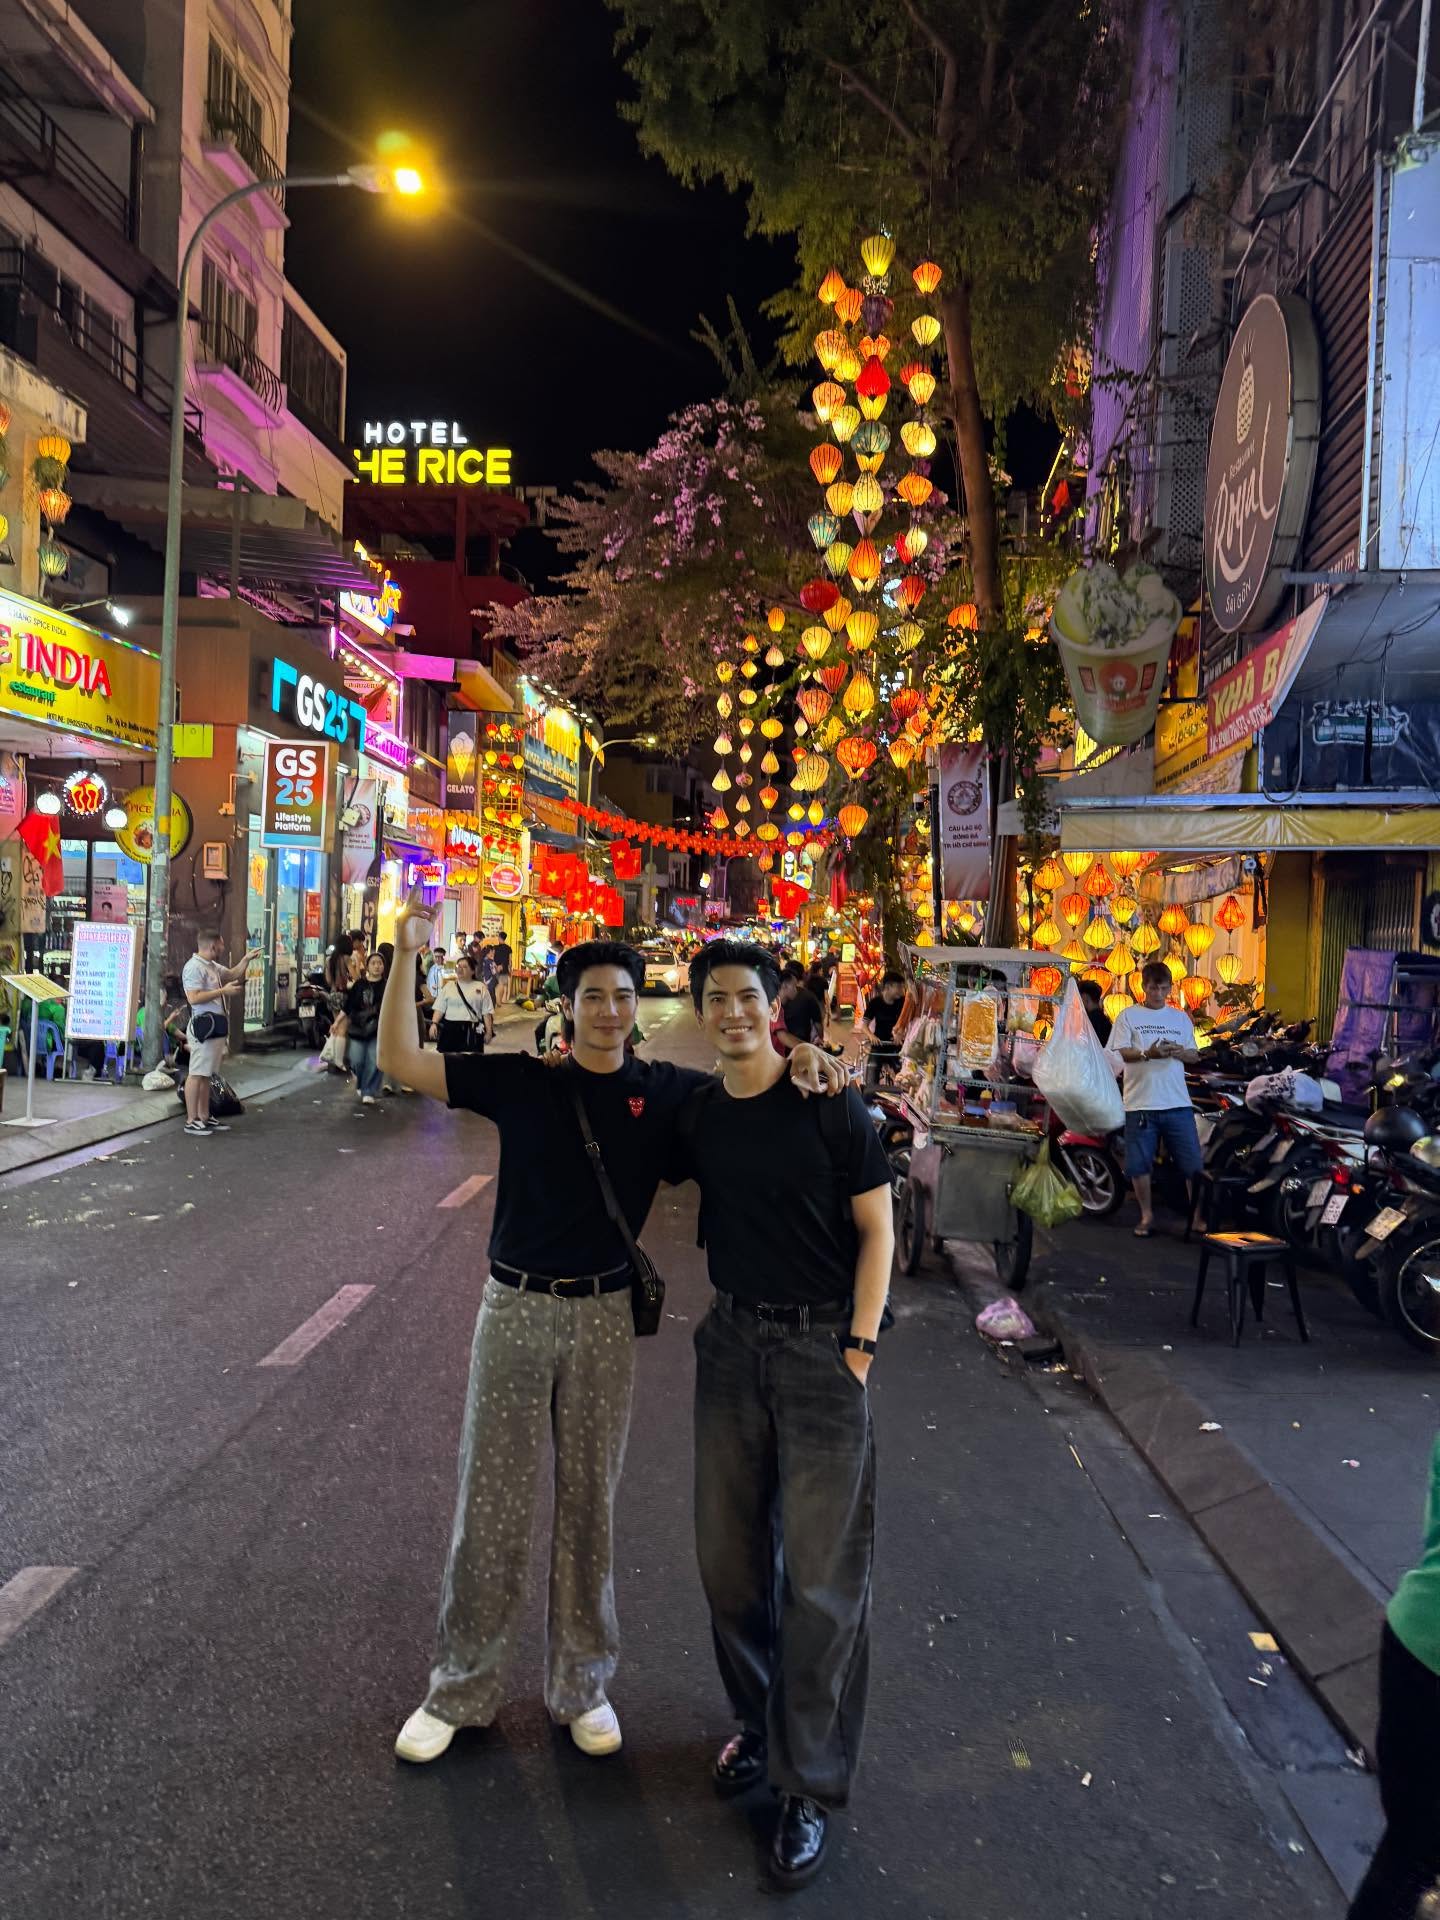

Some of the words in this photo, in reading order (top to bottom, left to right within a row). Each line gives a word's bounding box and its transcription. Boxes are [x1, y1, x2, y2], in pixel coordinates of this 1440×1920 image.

[365, 422, 468, 445] HOTEL
[418, 449, 512, 484] RICE
[1210, 402, 1277, 587] Royal
[19, 631, 113, 699] INDIA
[296, 674, 349, 744] GS25
[275, 748, 317, 778] GS
[275, 778, 314, 807] 25
[446, 784, 475, 794] GELATO
[275, 812, 312, 825] Lifestyle
[275, 821, 312, 832] Platform
